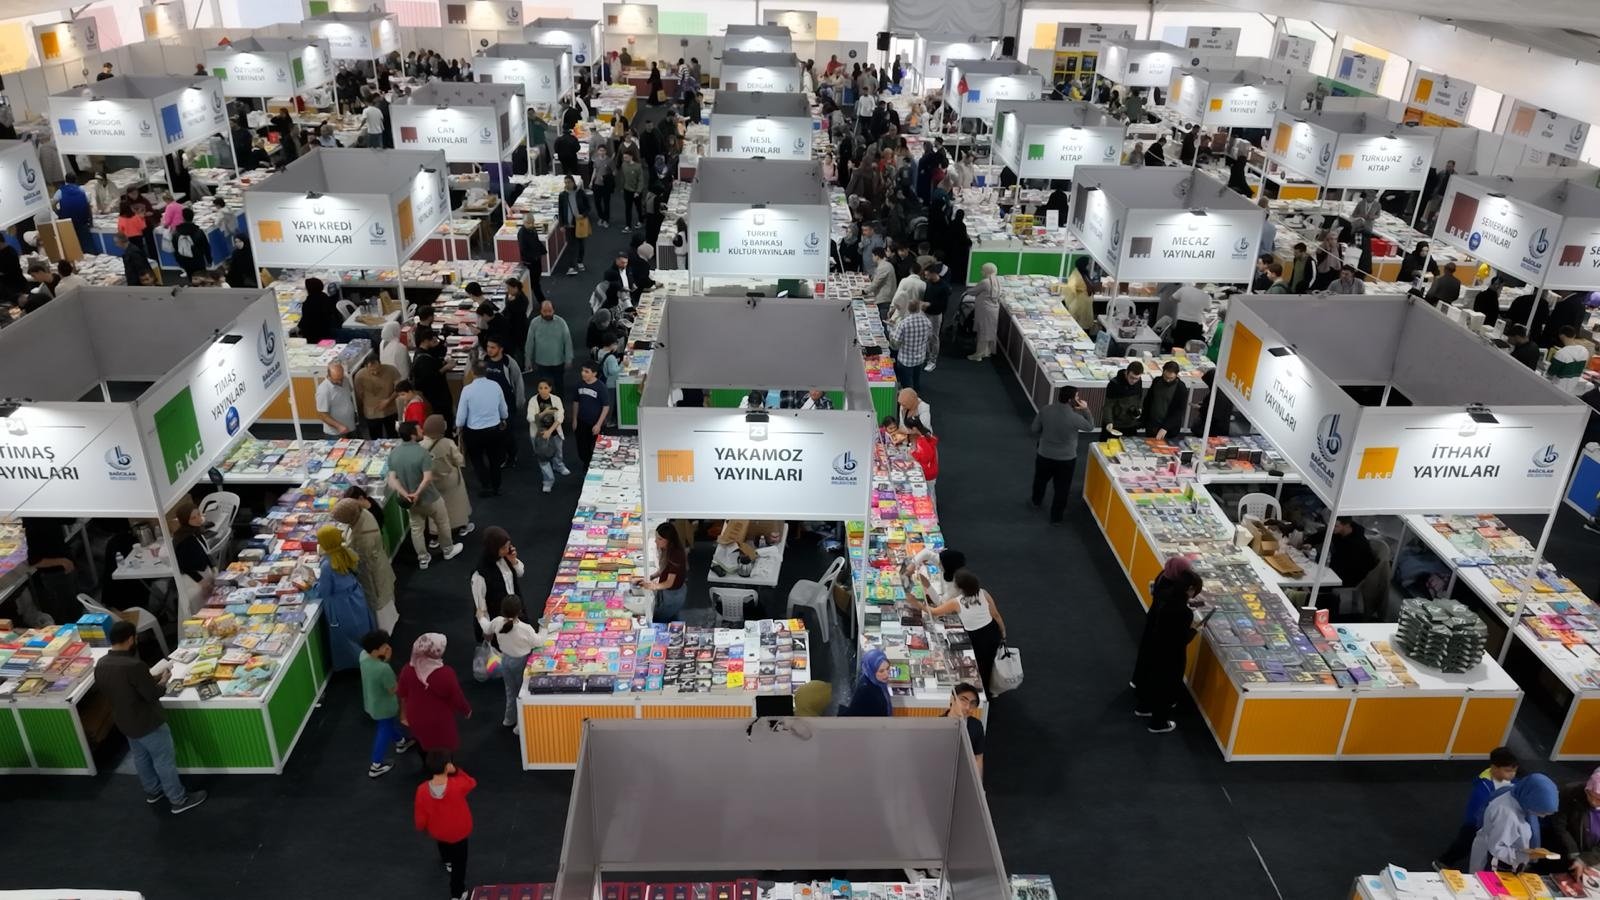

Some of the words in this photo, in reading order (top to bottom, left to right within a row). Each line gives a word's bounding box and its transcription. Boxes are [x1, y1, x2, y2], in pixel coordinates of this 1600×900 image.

[88, 129, 126, 137] YAYINLARI
[426, 136, 468, 144] YAYINLARI
[741, 146, 781, 154] YAYINLARI
[1361, 154, 1402, 163] TURKUVAZ
[292, 220, 317, 231] YAPI
[319, 220, 352, 231] KREDİ
[1481, 216, 1519, 238] SEMERKAND
[296, 233, 352, 245] YAYINLARI
[749, 239, 783, 247] BANKASI
[1172, 236, 1210, 246] MECAZ
[1481, 230, 1511, 249] YAYINLARI
[758, 247, 796, 256] YAYINLARI
[1162, 249, 1215, 259] YAYINLARI
[1229, 371, 1252, 401] BKF
[211, 380, 247, 421] YAYINLARI
[1264, 390, 1297, 432] YAYINLARI
[751, 425, 765, 437] 23
[0, 442, 55, 464] TİMAŞ
[714, 447, 803, 462] YAKAMOZ
[1431, 442, 1493, 459] İTHAKİ
[175, 441, 205, 477] BKF
[0, 465, 79, 481] AYINLARI
[714, 466, 803, 482] YAYINLARI
[1413, 464, 1501, 480] YAYINLARI
